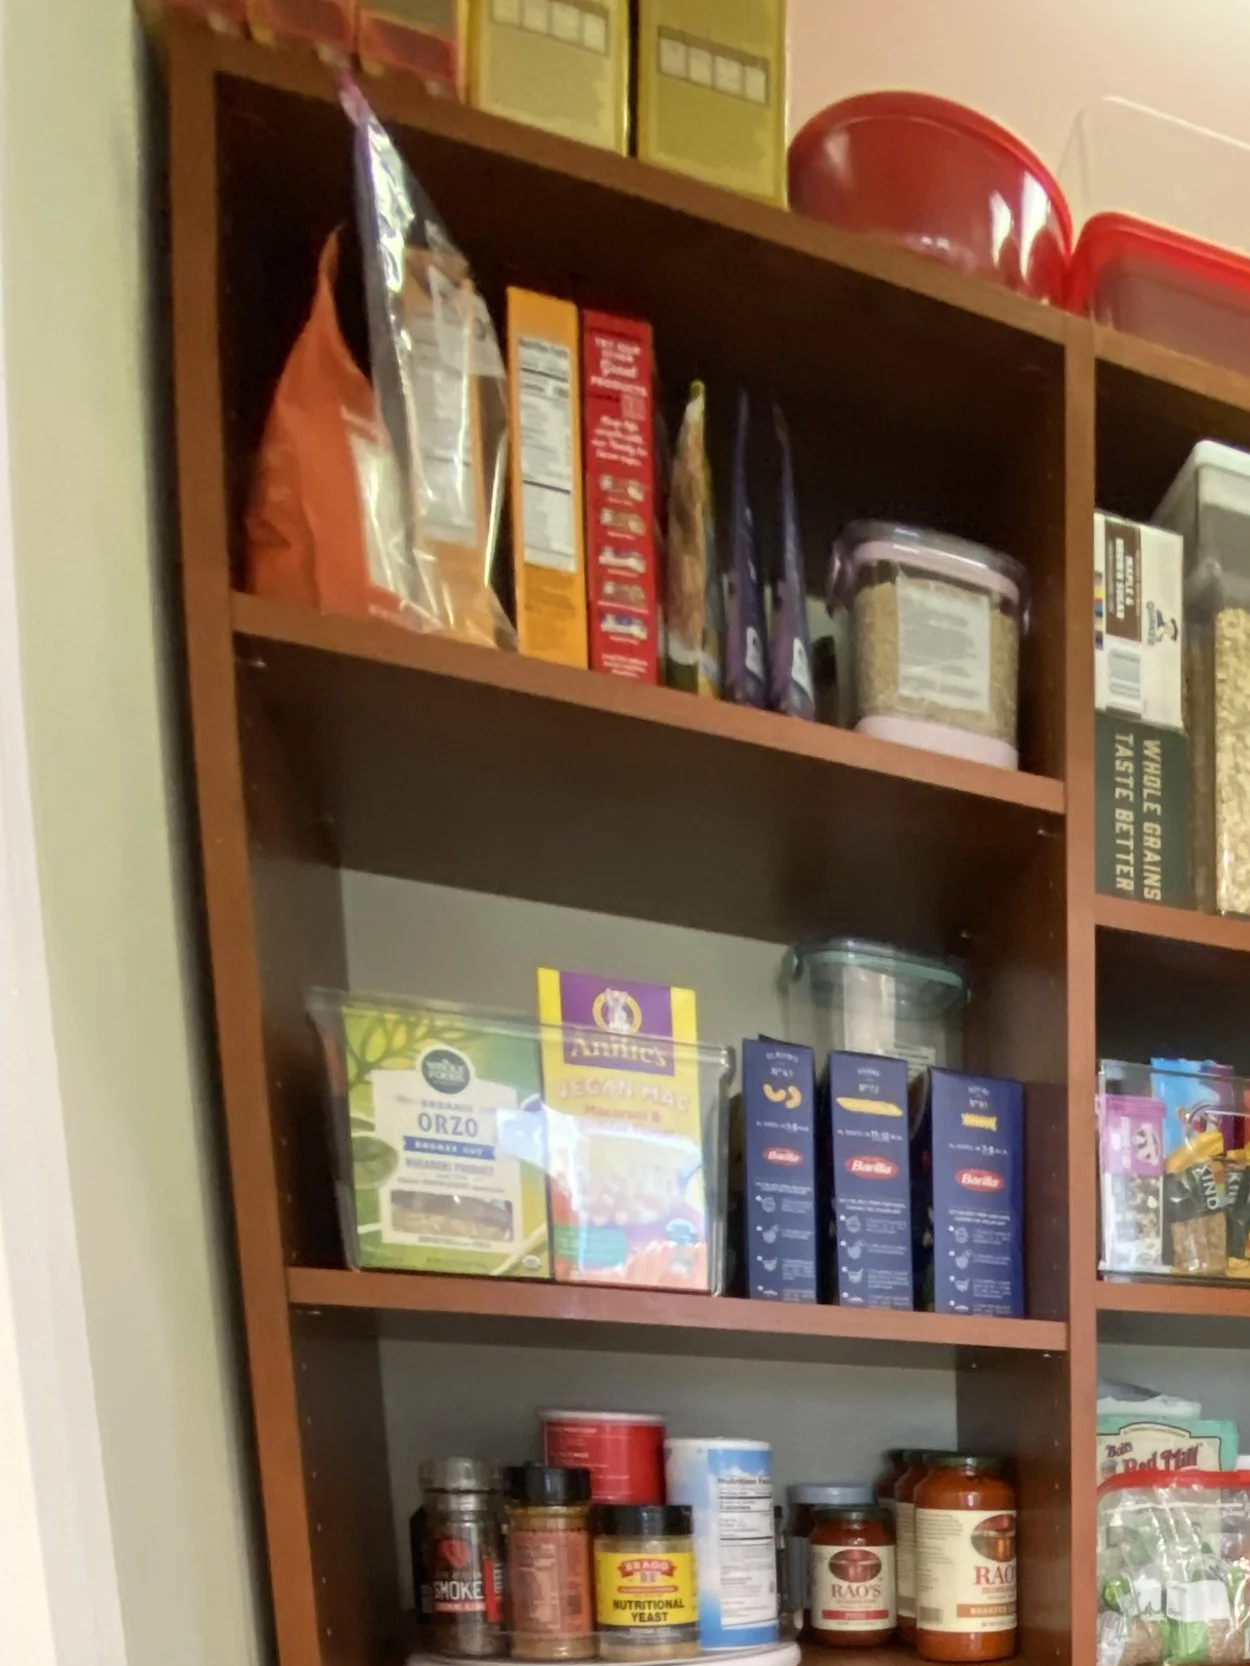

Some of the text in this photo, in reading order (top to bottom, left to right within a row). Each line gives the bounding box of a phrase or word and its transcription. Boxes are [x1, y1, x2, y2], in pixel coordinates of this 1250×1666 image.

[1124, 556, 1134, 592] MAPLE
[1114, 733, 1135, 891] TASTE BETTER
[1142, 739, 1162, 901] WHOLE GRAINS
[555, 1074, 691, 1113] VEGAN MAC
[417, 1112, 479, 1138] ORZO
[767, 1149, 802, 1164] Barilla
[851, 1159, 893, 1177] Barilla
[960, 1172, 1002, 1188] Barilla
[1191, 1162, 1221, 1211] KIND
[624, 1560, 669, 1572] BRAGG
[434, 1580, 485, 1600] SMOKE
[831, 1582, 882, 1599] RAO'S
[612, 1599, 685, 1610] NUTRITIONAL
[630, 1611, 669, 1623] YEAST
